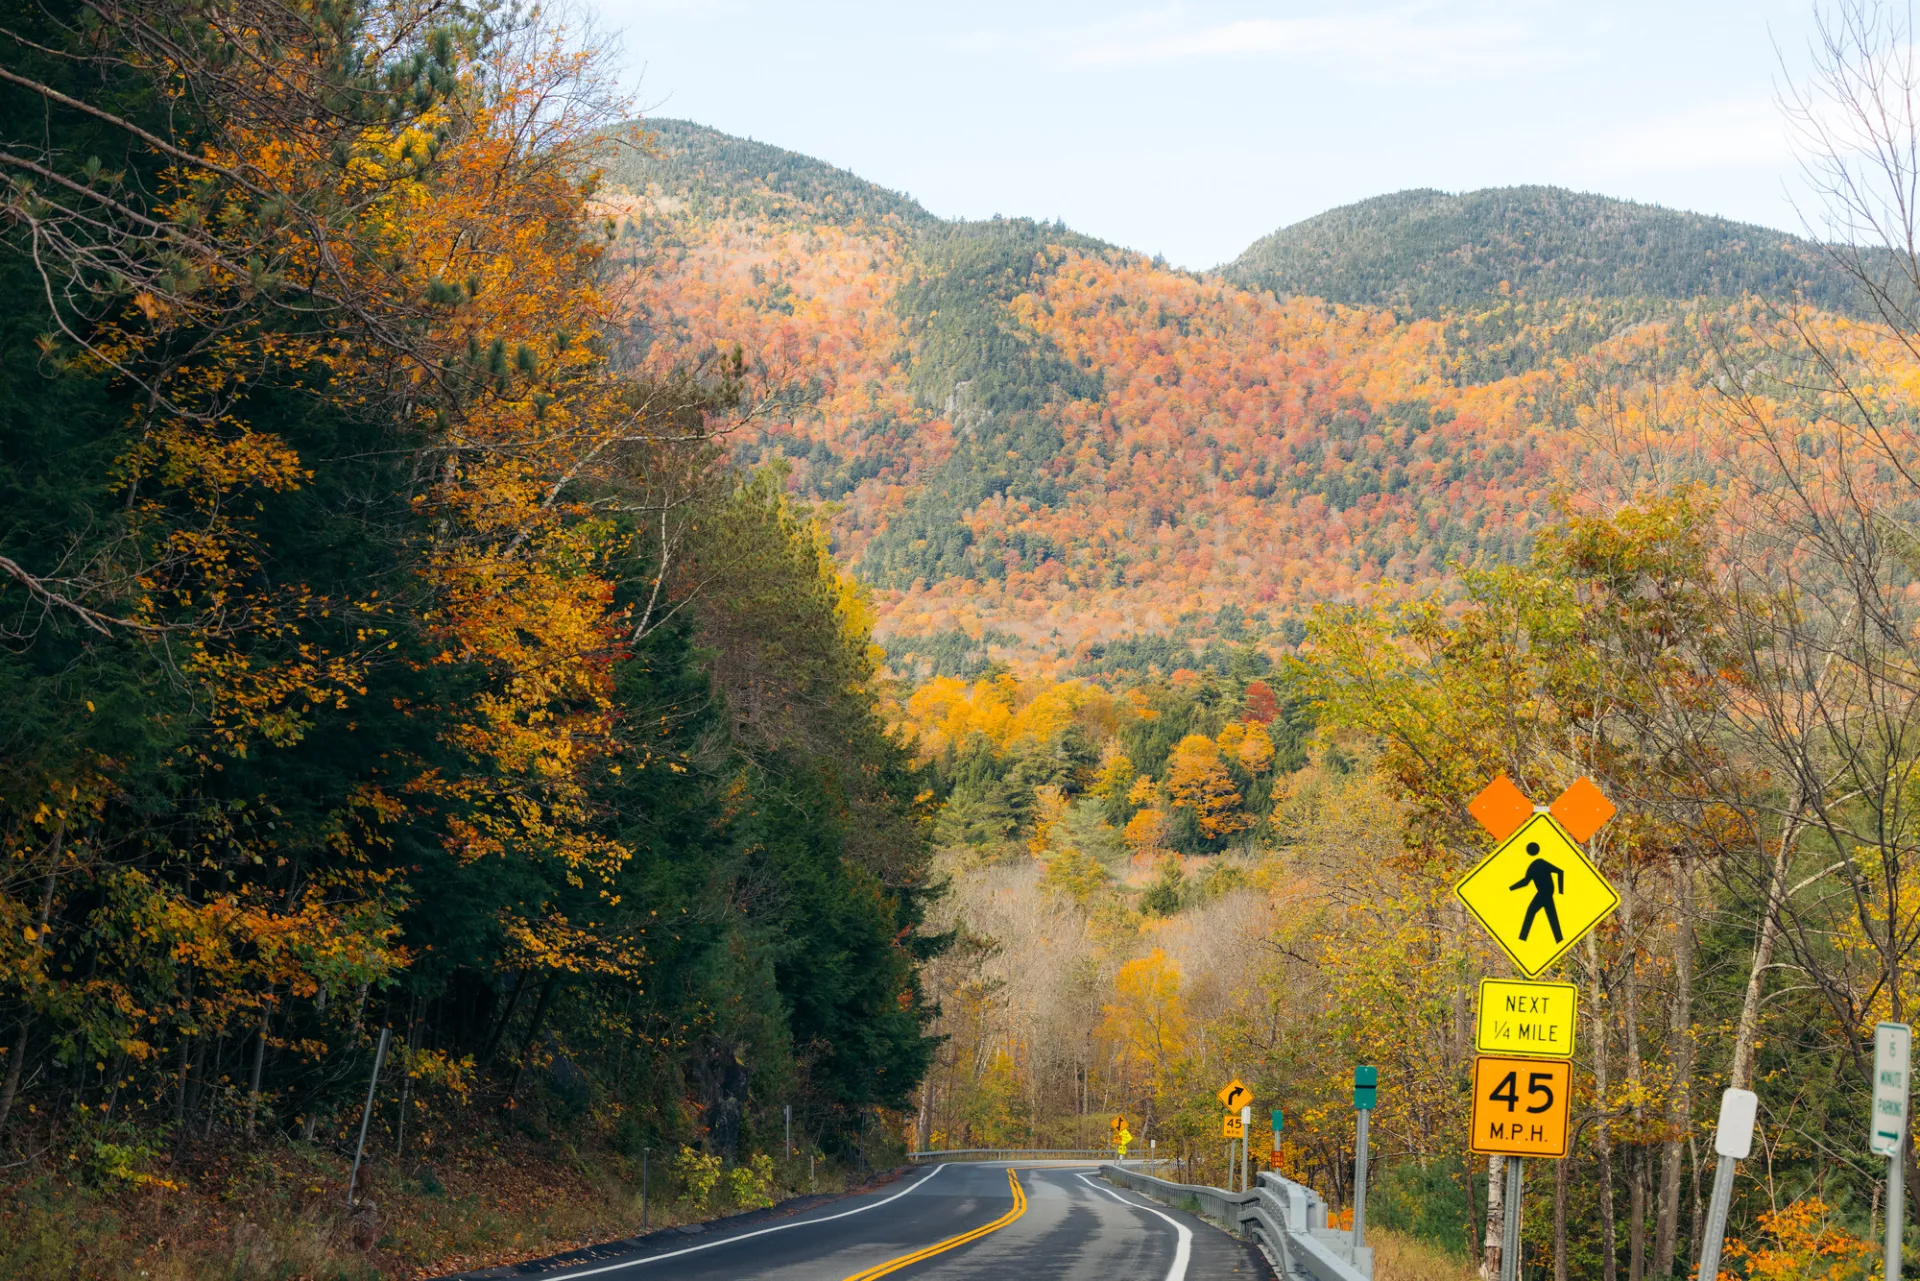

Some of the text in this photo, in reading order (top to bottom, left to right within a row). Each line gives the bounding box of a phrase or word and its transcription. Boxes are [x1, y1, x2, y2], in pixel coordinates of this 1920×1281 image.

[1506, 995, 1550, 1014] NEXT
[1518, 1023, 1558, 1042] MILE
[1489, 1071, 1554, 1113] 45
[1227, 1118, 1242, 1128] 45
[1490, 1122, 1549, 1142] M.P.H.
